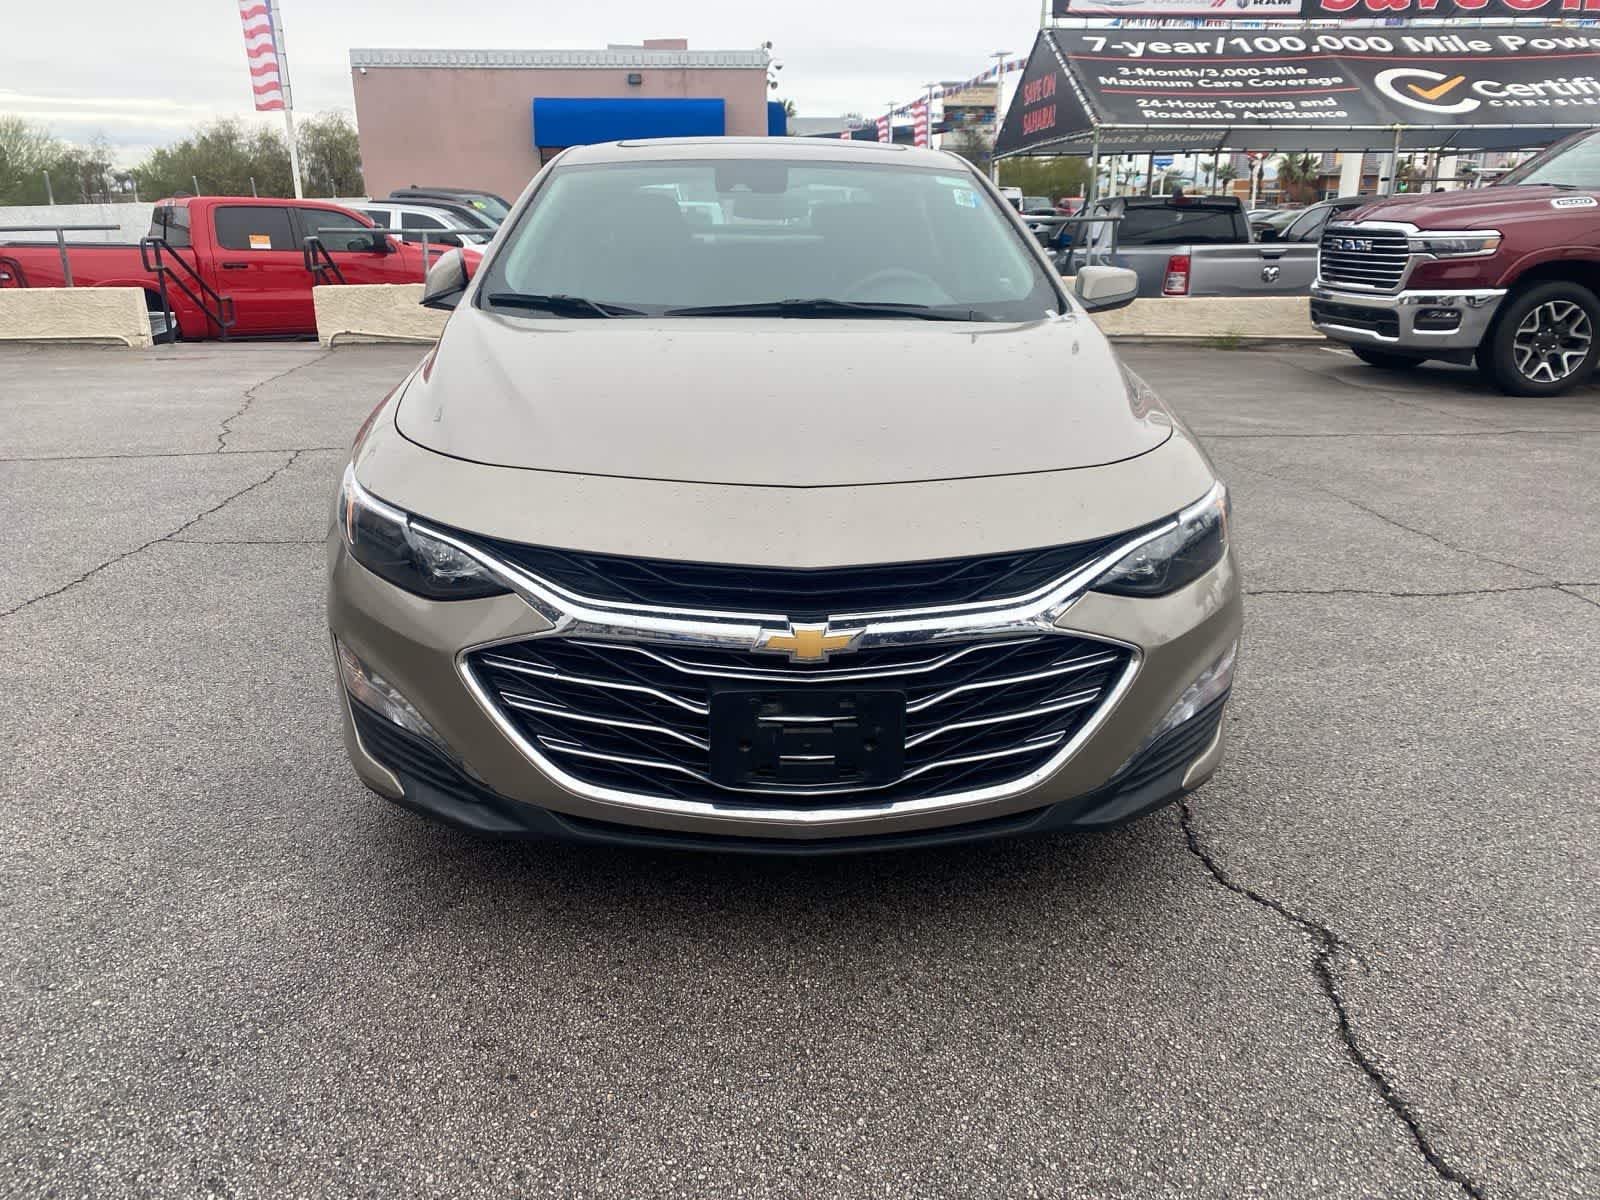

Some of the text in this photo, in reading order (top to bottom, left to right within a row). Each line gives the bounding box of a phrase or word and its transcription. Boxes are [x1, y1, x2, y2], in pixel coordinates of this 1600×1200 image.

[1401, 35, 1493, 52] Mile
[1117, 66, 1308, 78] 3-Month/3,000-Mile
[1098, 76, 1344, 88] Maximum Care Coverage
[1023, 79, 1042, 107] SAVE
[1136, 97, 1338, 110] 24-Hour Towing and
[1142, 109, 1348, 119] Roadside Assistance
[1331, 238, 1374, 251] RAM
